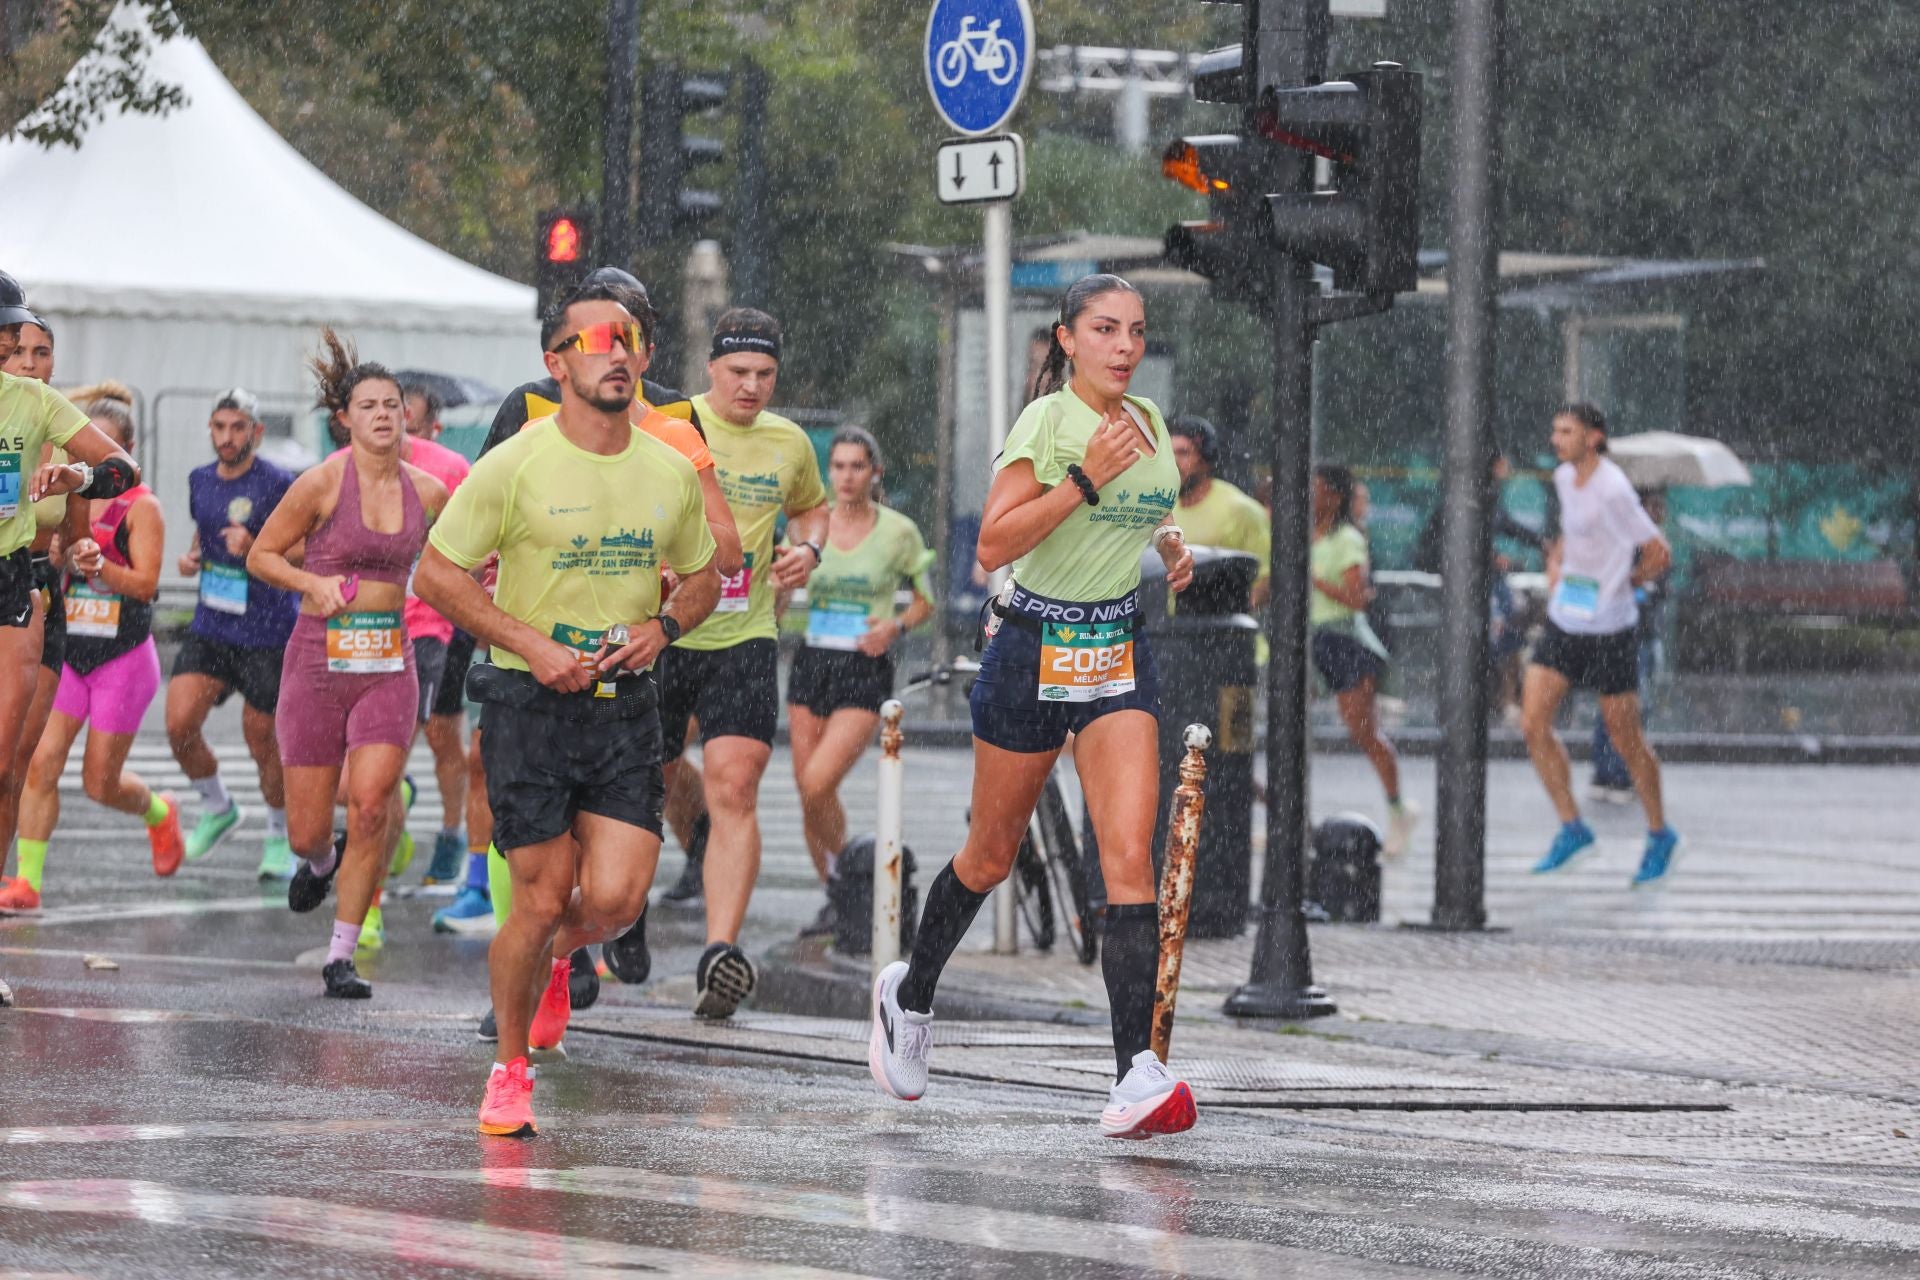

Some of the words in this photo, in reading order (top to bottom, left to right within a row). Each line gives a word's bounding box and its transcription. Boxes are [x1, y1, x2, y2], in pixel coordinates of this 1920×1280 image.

[552, 559, 592, 570] DONOSTIA
[601, 559, 616, 568] SAN
[1024, 598, 1084, 622] PRO
[1090, 597, 1134, 622] NIKE
[338, 628, 393, 650] 2631
[1079, 631, 1105, 641] RURAL
[1106, 627, 1125, 640] KUTXA
[1052, 643, 1126, 673] 2082
